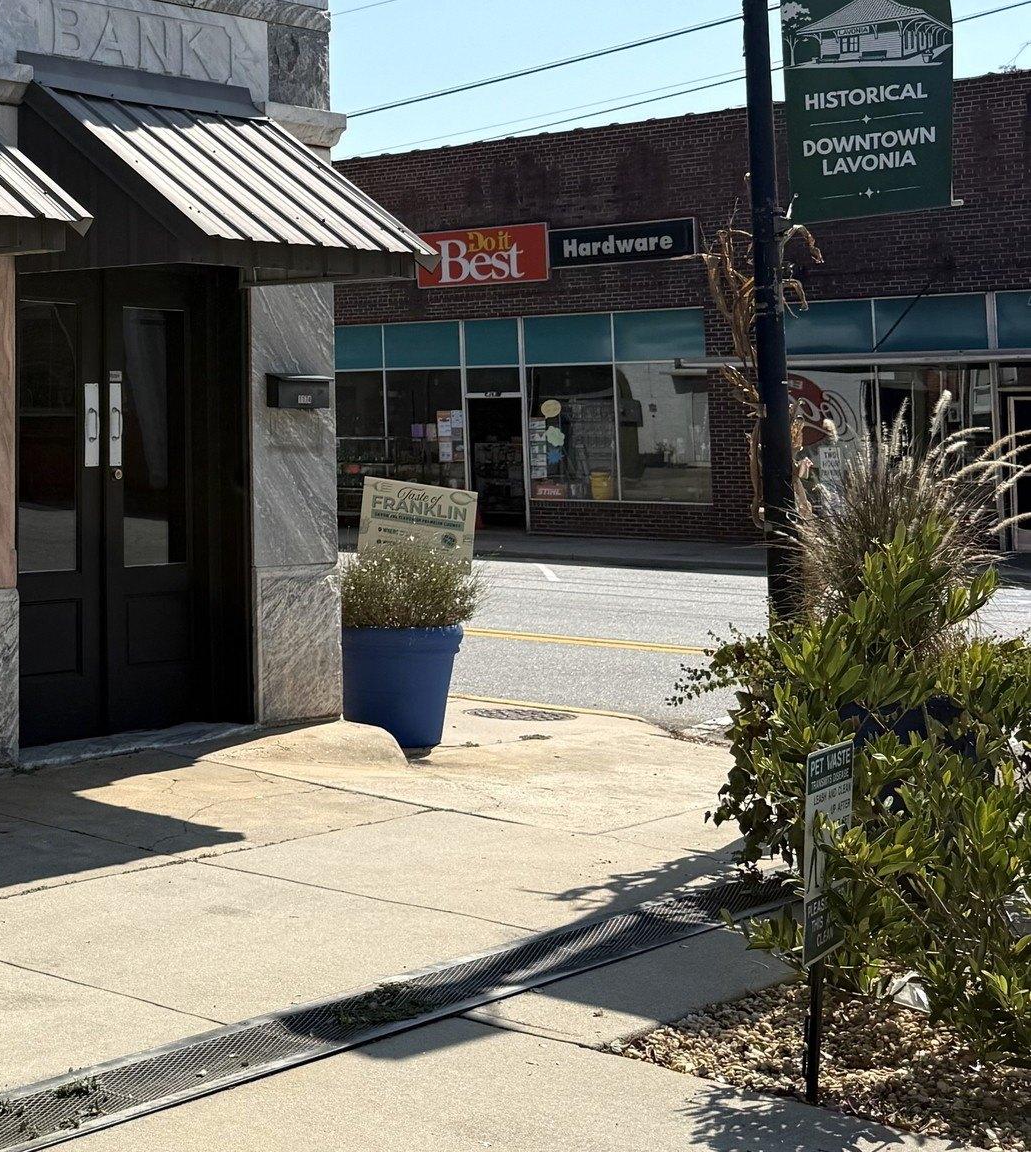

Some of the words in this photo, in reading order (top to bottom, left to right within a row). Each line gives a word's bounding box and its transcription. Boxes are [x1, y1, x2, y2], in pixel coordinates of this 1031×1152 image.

[47, 0, 221, 83] BANK
[838, 26, 868, 36] LAVONIA
[805, 82, 928, 111] HISTORICAL
[803, 126, 936, 158] DOWNTOWN
[822, 149, 917, 177] LAVONIA
[468, 231, 496, 253] Do
[497, 230, 512, 250] it
[562, 234, 673, 258] Hardware
[436, 239, 525, 284] Best
[397, 486, 429, 503] Taste
[430, 494, 445, 510] of
[536, 487, 563, 496] STIHL
[371, 494, 468, 522] FRANKLIN
[810, 757, 825, 778] PET
[826, 748, 851, 771] WASTE
[832, 767, 850, 783] DISEASE
[813, 791, 827, 806] LEASH
[836, 783, 851, 796] CLEAN
[837, 798, 851, 811] AFTER
[808, 896, 829, 918] PLEAS
